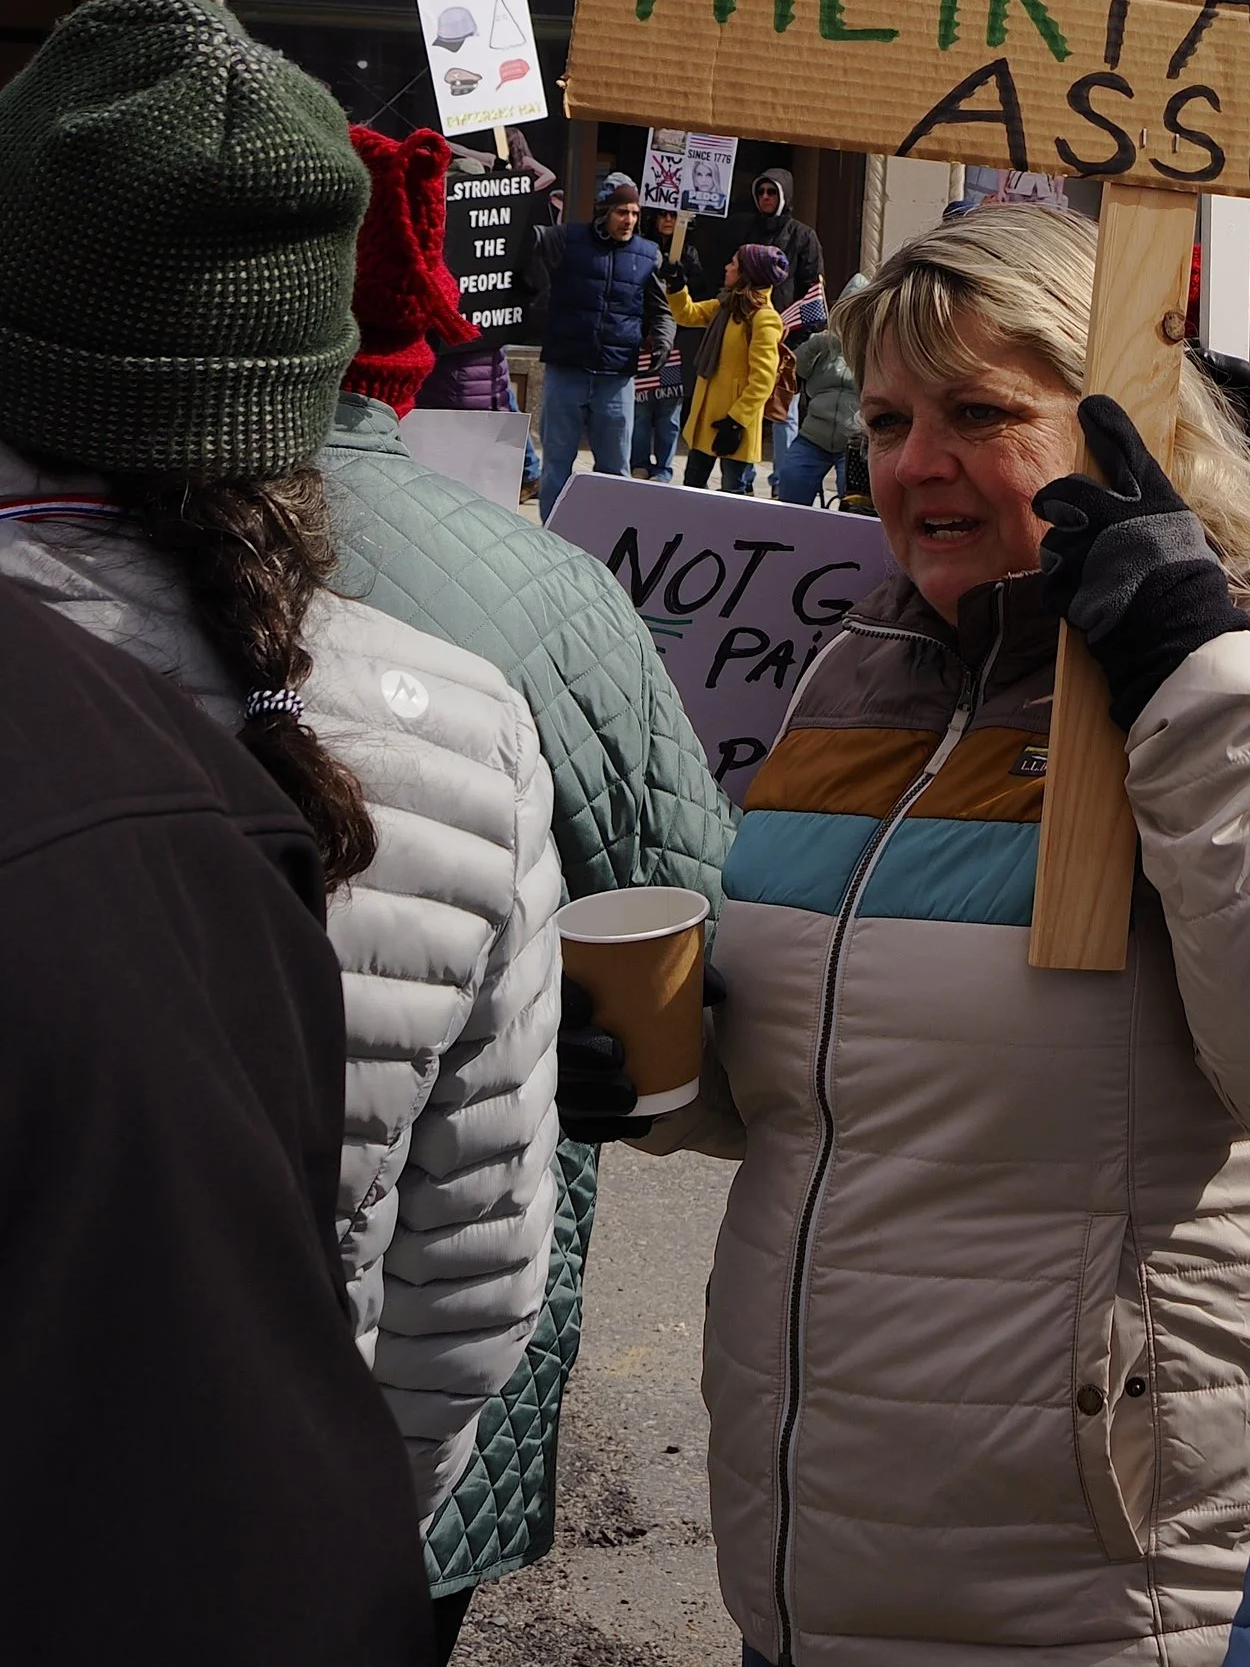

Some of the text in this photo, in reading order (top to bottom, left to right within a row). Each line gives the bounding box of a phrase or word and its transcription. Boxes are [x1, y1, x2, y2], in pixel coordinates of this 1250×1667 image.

[687, 149, 732, 165] SINCE 1776
[688, 190, 720, 202] PEDO
[469, 207, 511, 228] THAN
[474, 238, 506, 258] THE
[459, 271, 513, 294] PEOPLE
[472, 306, 523, 328] POWER
[655, 384, 684, 400] OKAY!
[606, 526, 795, 618] NOT
